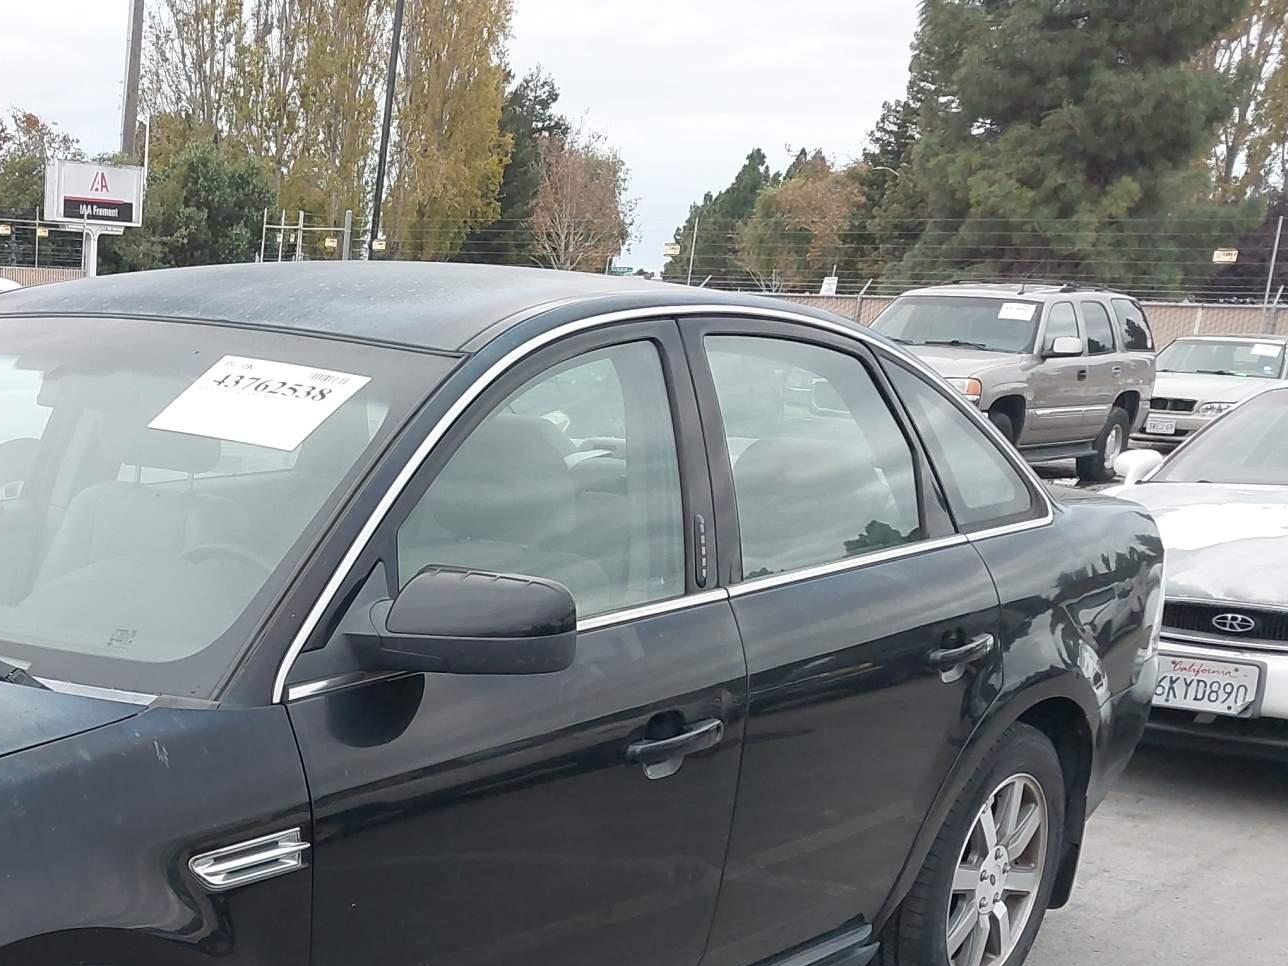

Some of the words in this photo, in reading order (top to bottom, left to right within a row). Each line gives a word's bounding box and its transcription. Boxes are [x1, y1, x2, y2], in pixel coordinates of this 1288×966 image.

[79, 204, 92, 215] IAA
[93, 205, 119, 217] Fremont
[213, 373, 332, 401] 43762538
[1172, 661, 1233, 678] California
[1154, 675, 1249, 705] 6KYD890
